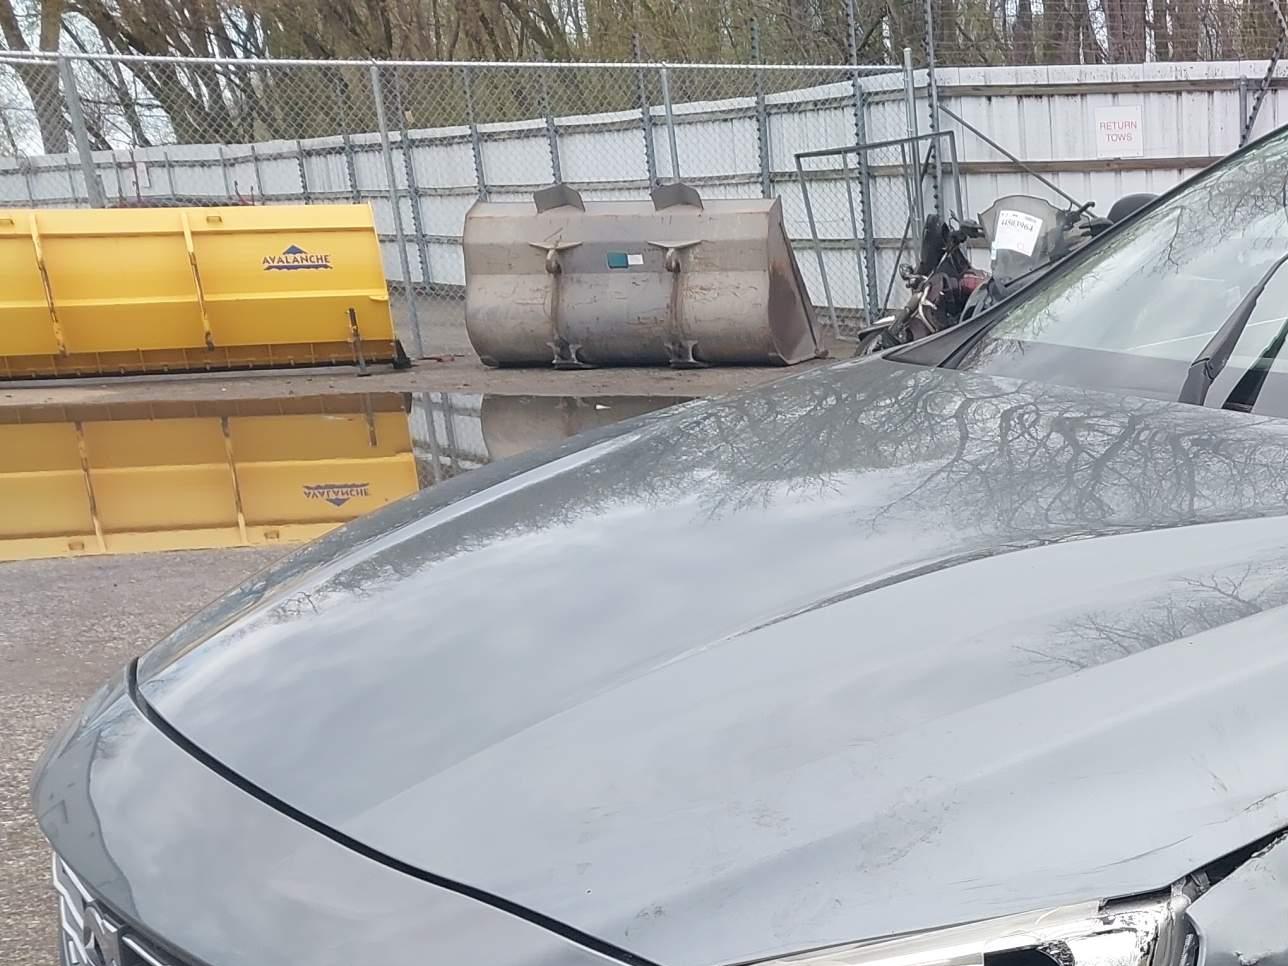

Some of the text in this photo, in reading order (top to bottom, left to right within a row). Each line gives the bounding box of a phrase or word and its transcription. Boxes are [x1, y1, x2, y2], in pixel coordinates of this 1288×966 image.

[1099, 120, 1137, 130] RETURN
[1104, 132, 1133, 142] TOWS
[262, 254, 331, 265] AVALANCHE
